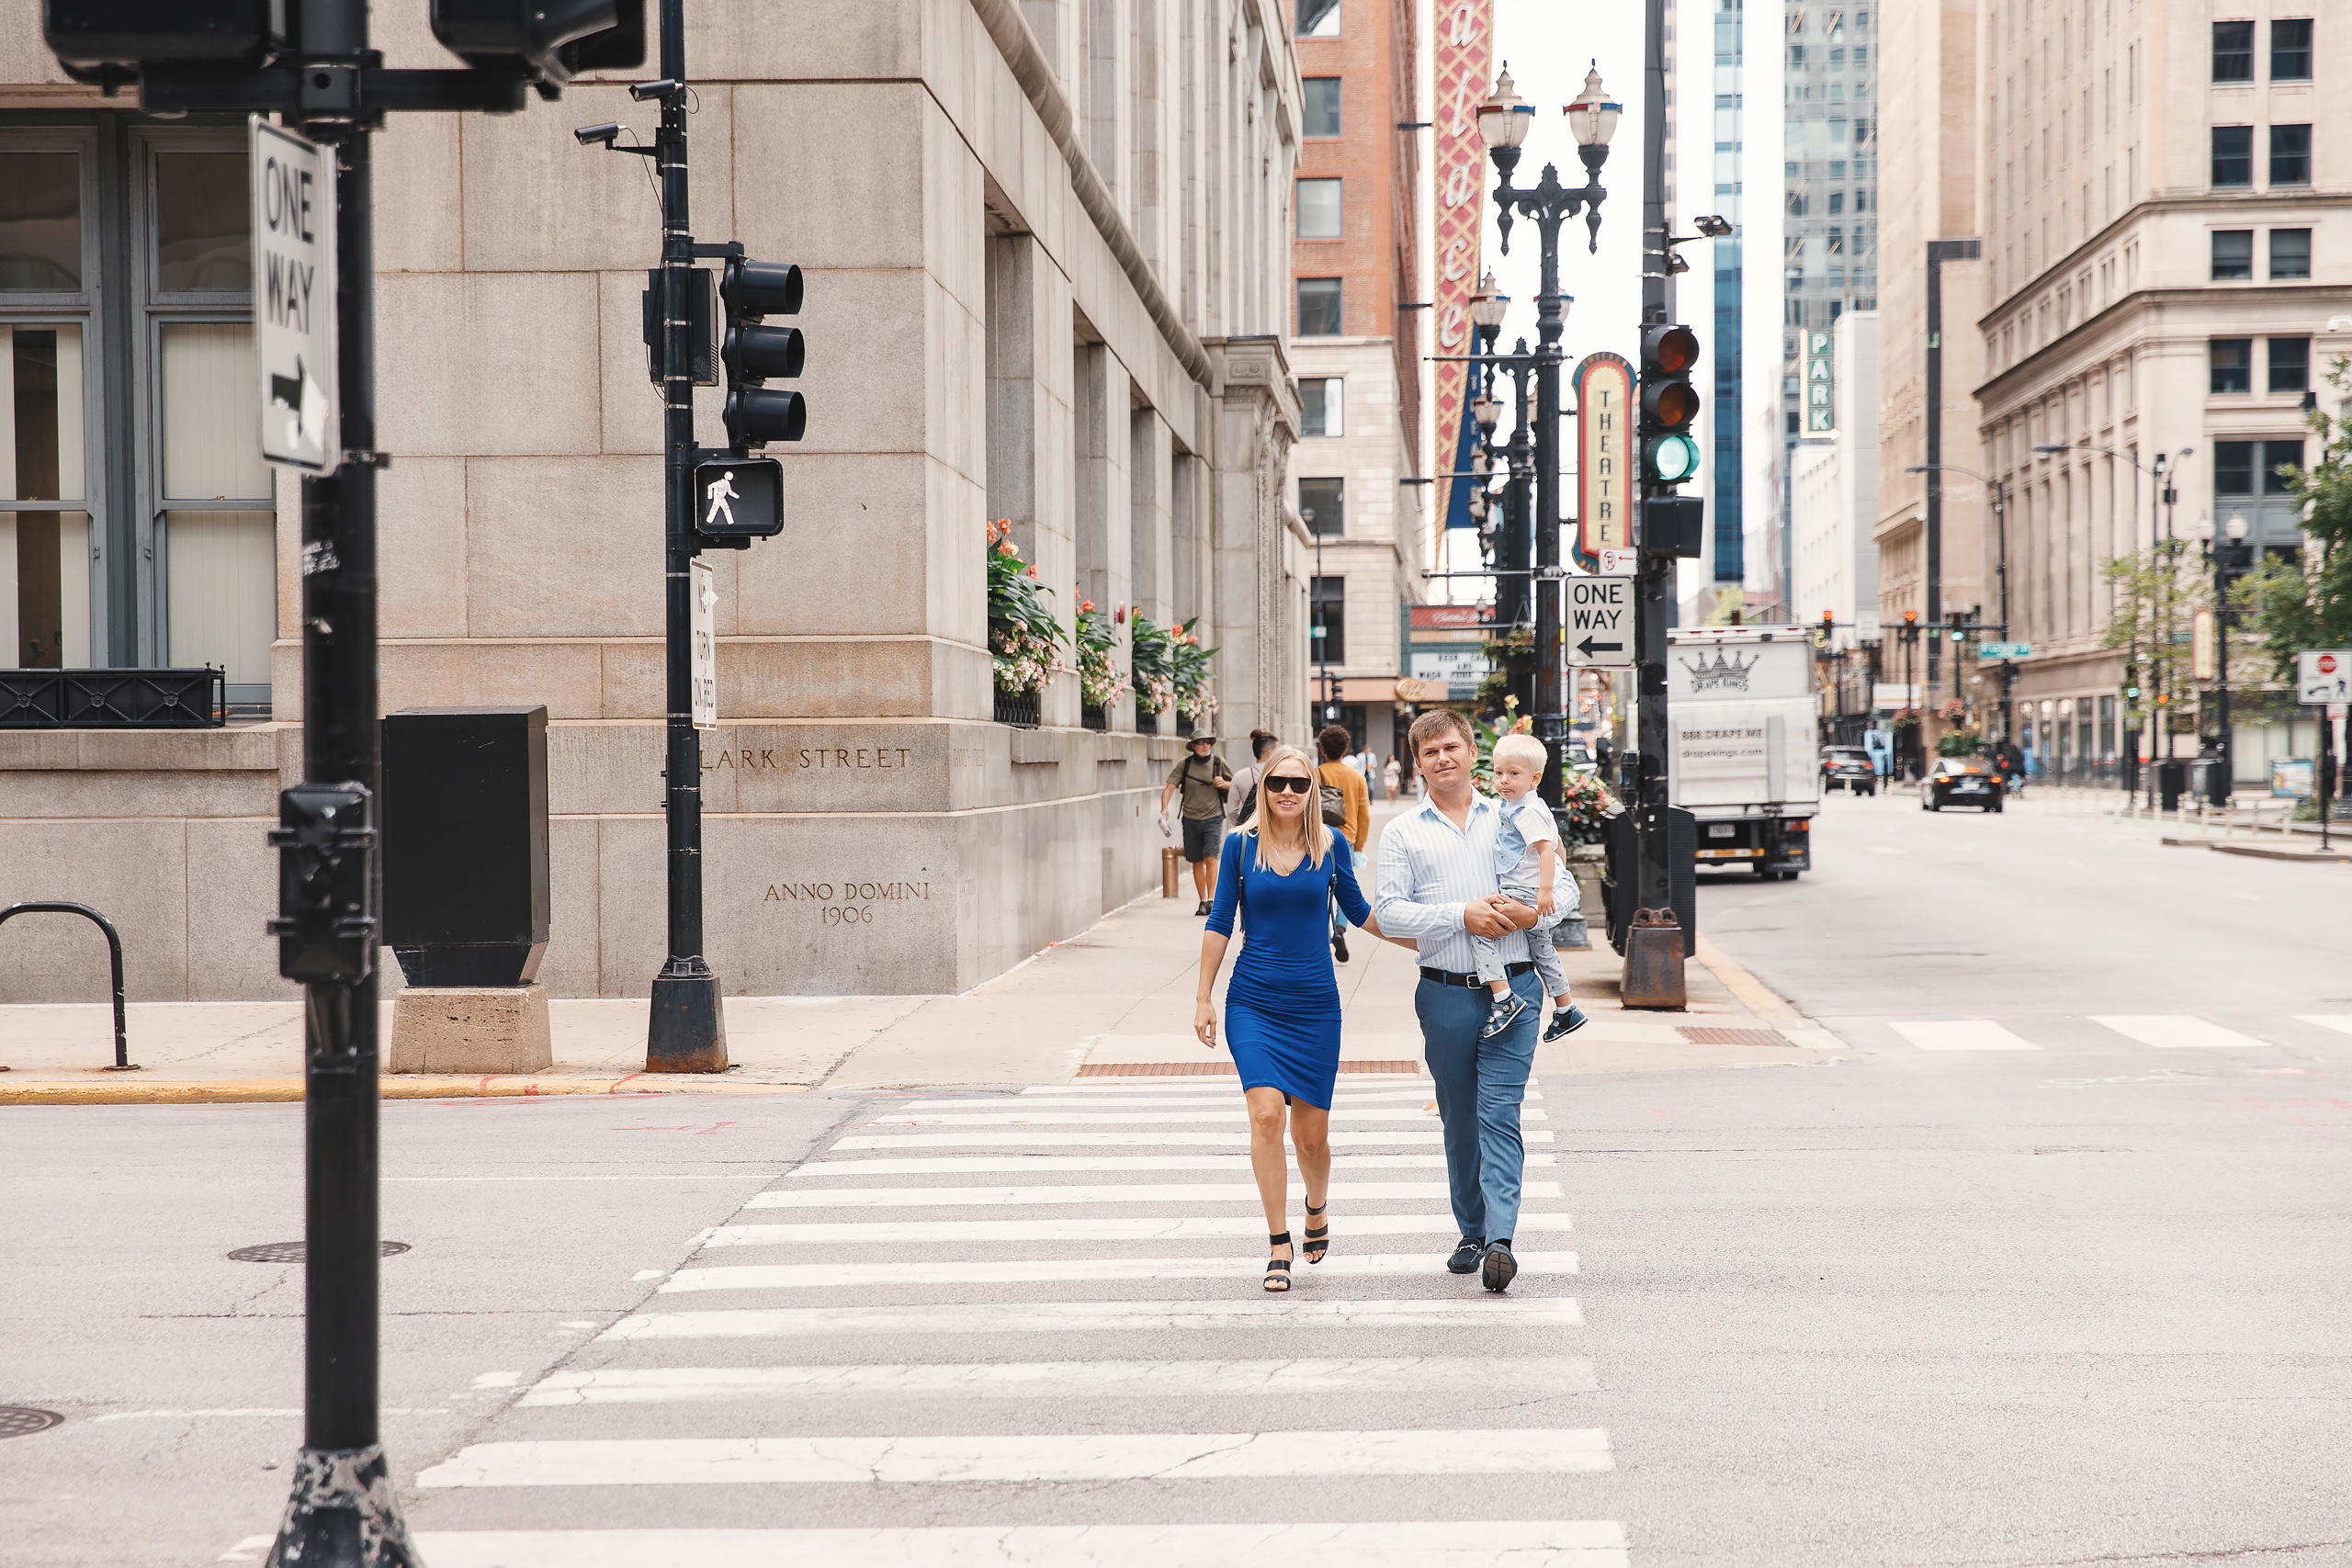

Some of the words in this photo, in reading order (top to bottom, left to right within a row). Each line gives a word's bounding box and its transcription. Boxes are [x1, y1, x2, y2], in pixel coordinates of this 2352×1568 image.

[266, 156, 315, 244] ONE
[266, 249, 315, 335] WAY
[1810, 333, 1829, 431] PARK
[1599, 390, 1611, 542] THEATRE
[1574, 583, 1623, 604] ONE
[1574, 609, 1623, 630] WAY
[696, 630, 711, 661] TURN
[695, 676, 702, 707] ON
[699, 750, 777, 771] LARK
[799, 749, 910, 769] STREET
[763, 884, 833, 901] ANNO
[844, 882, 931, 900] DOMINI
[822, 905, 873, 927] 1906
